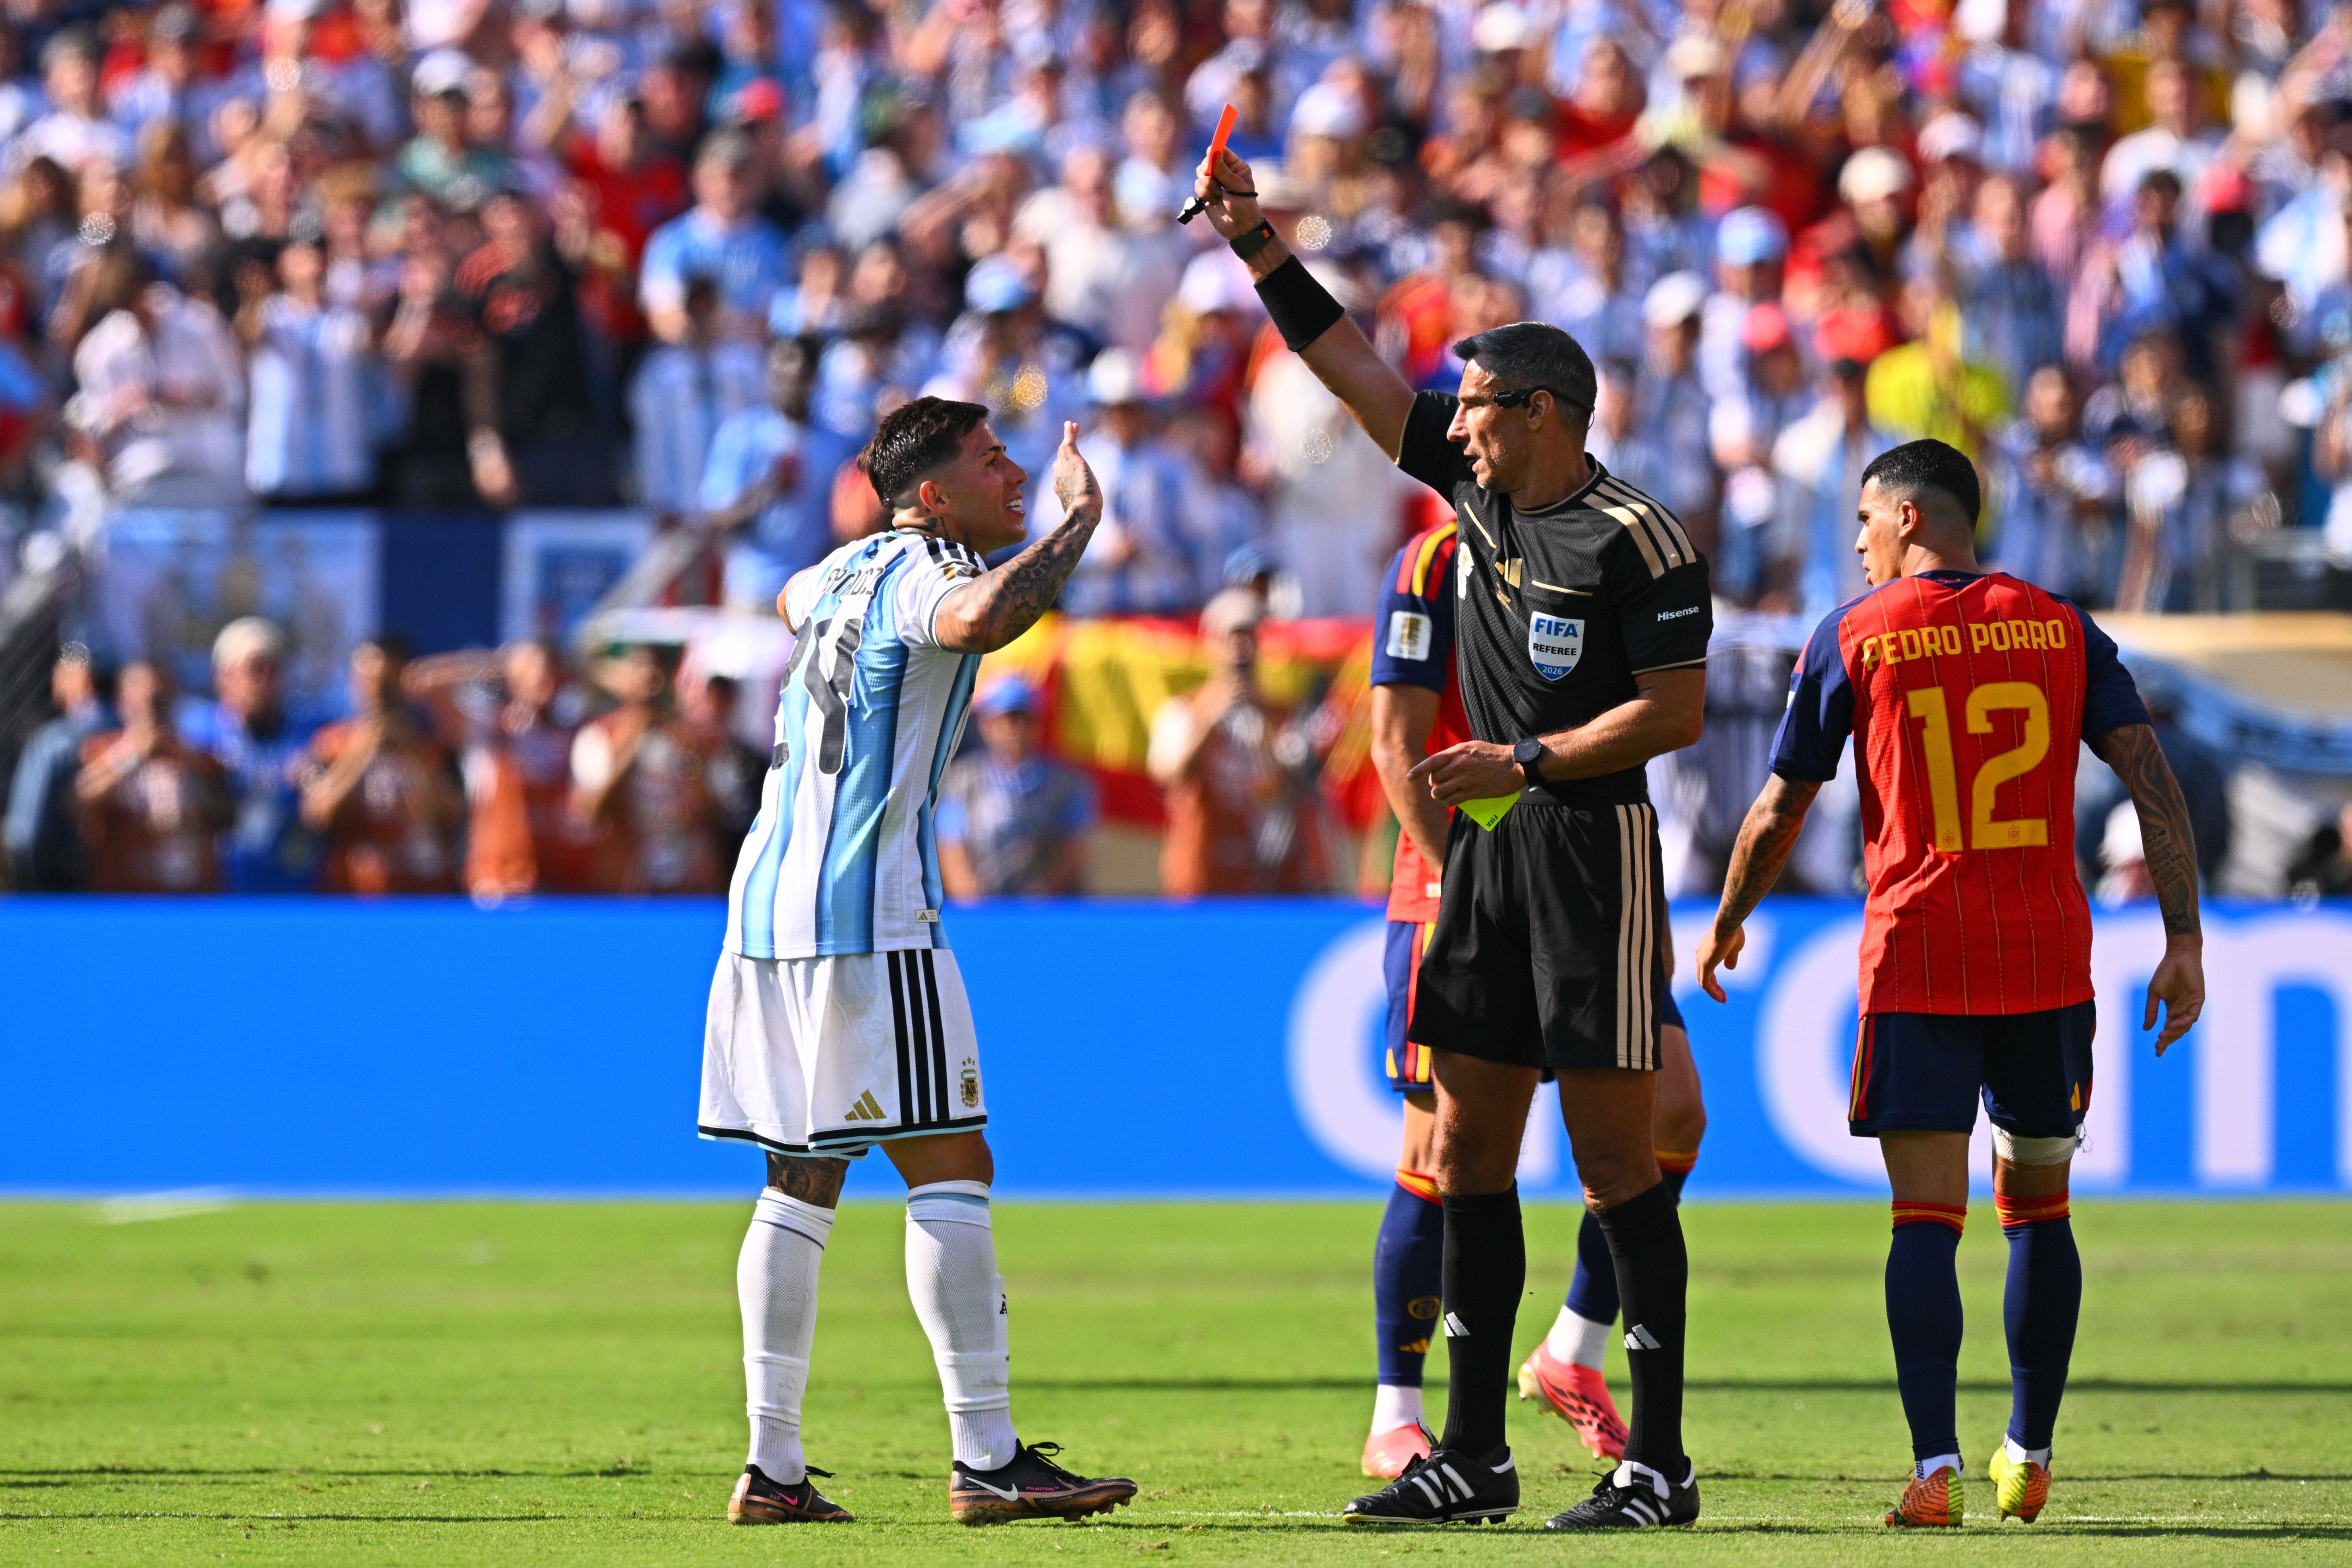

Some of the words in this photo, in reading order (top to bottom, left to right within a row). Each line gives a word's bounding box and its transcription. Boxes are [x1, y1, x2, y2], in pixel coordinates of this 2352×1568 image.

[1657, 606, 1699, 622] Hisense
[1535, 617, 1578, 638] FIFA
[1533, 643, 1577, 656] REFEREE
[1860, 625, 1962, 670] PEDRO
[1968, 619, 2066, 653] PORRO
[1542, 666, 1563, 675] 2026
[1907, 681, 2050, 852] 12
[1486, 814, 1498, 827] FIFA
